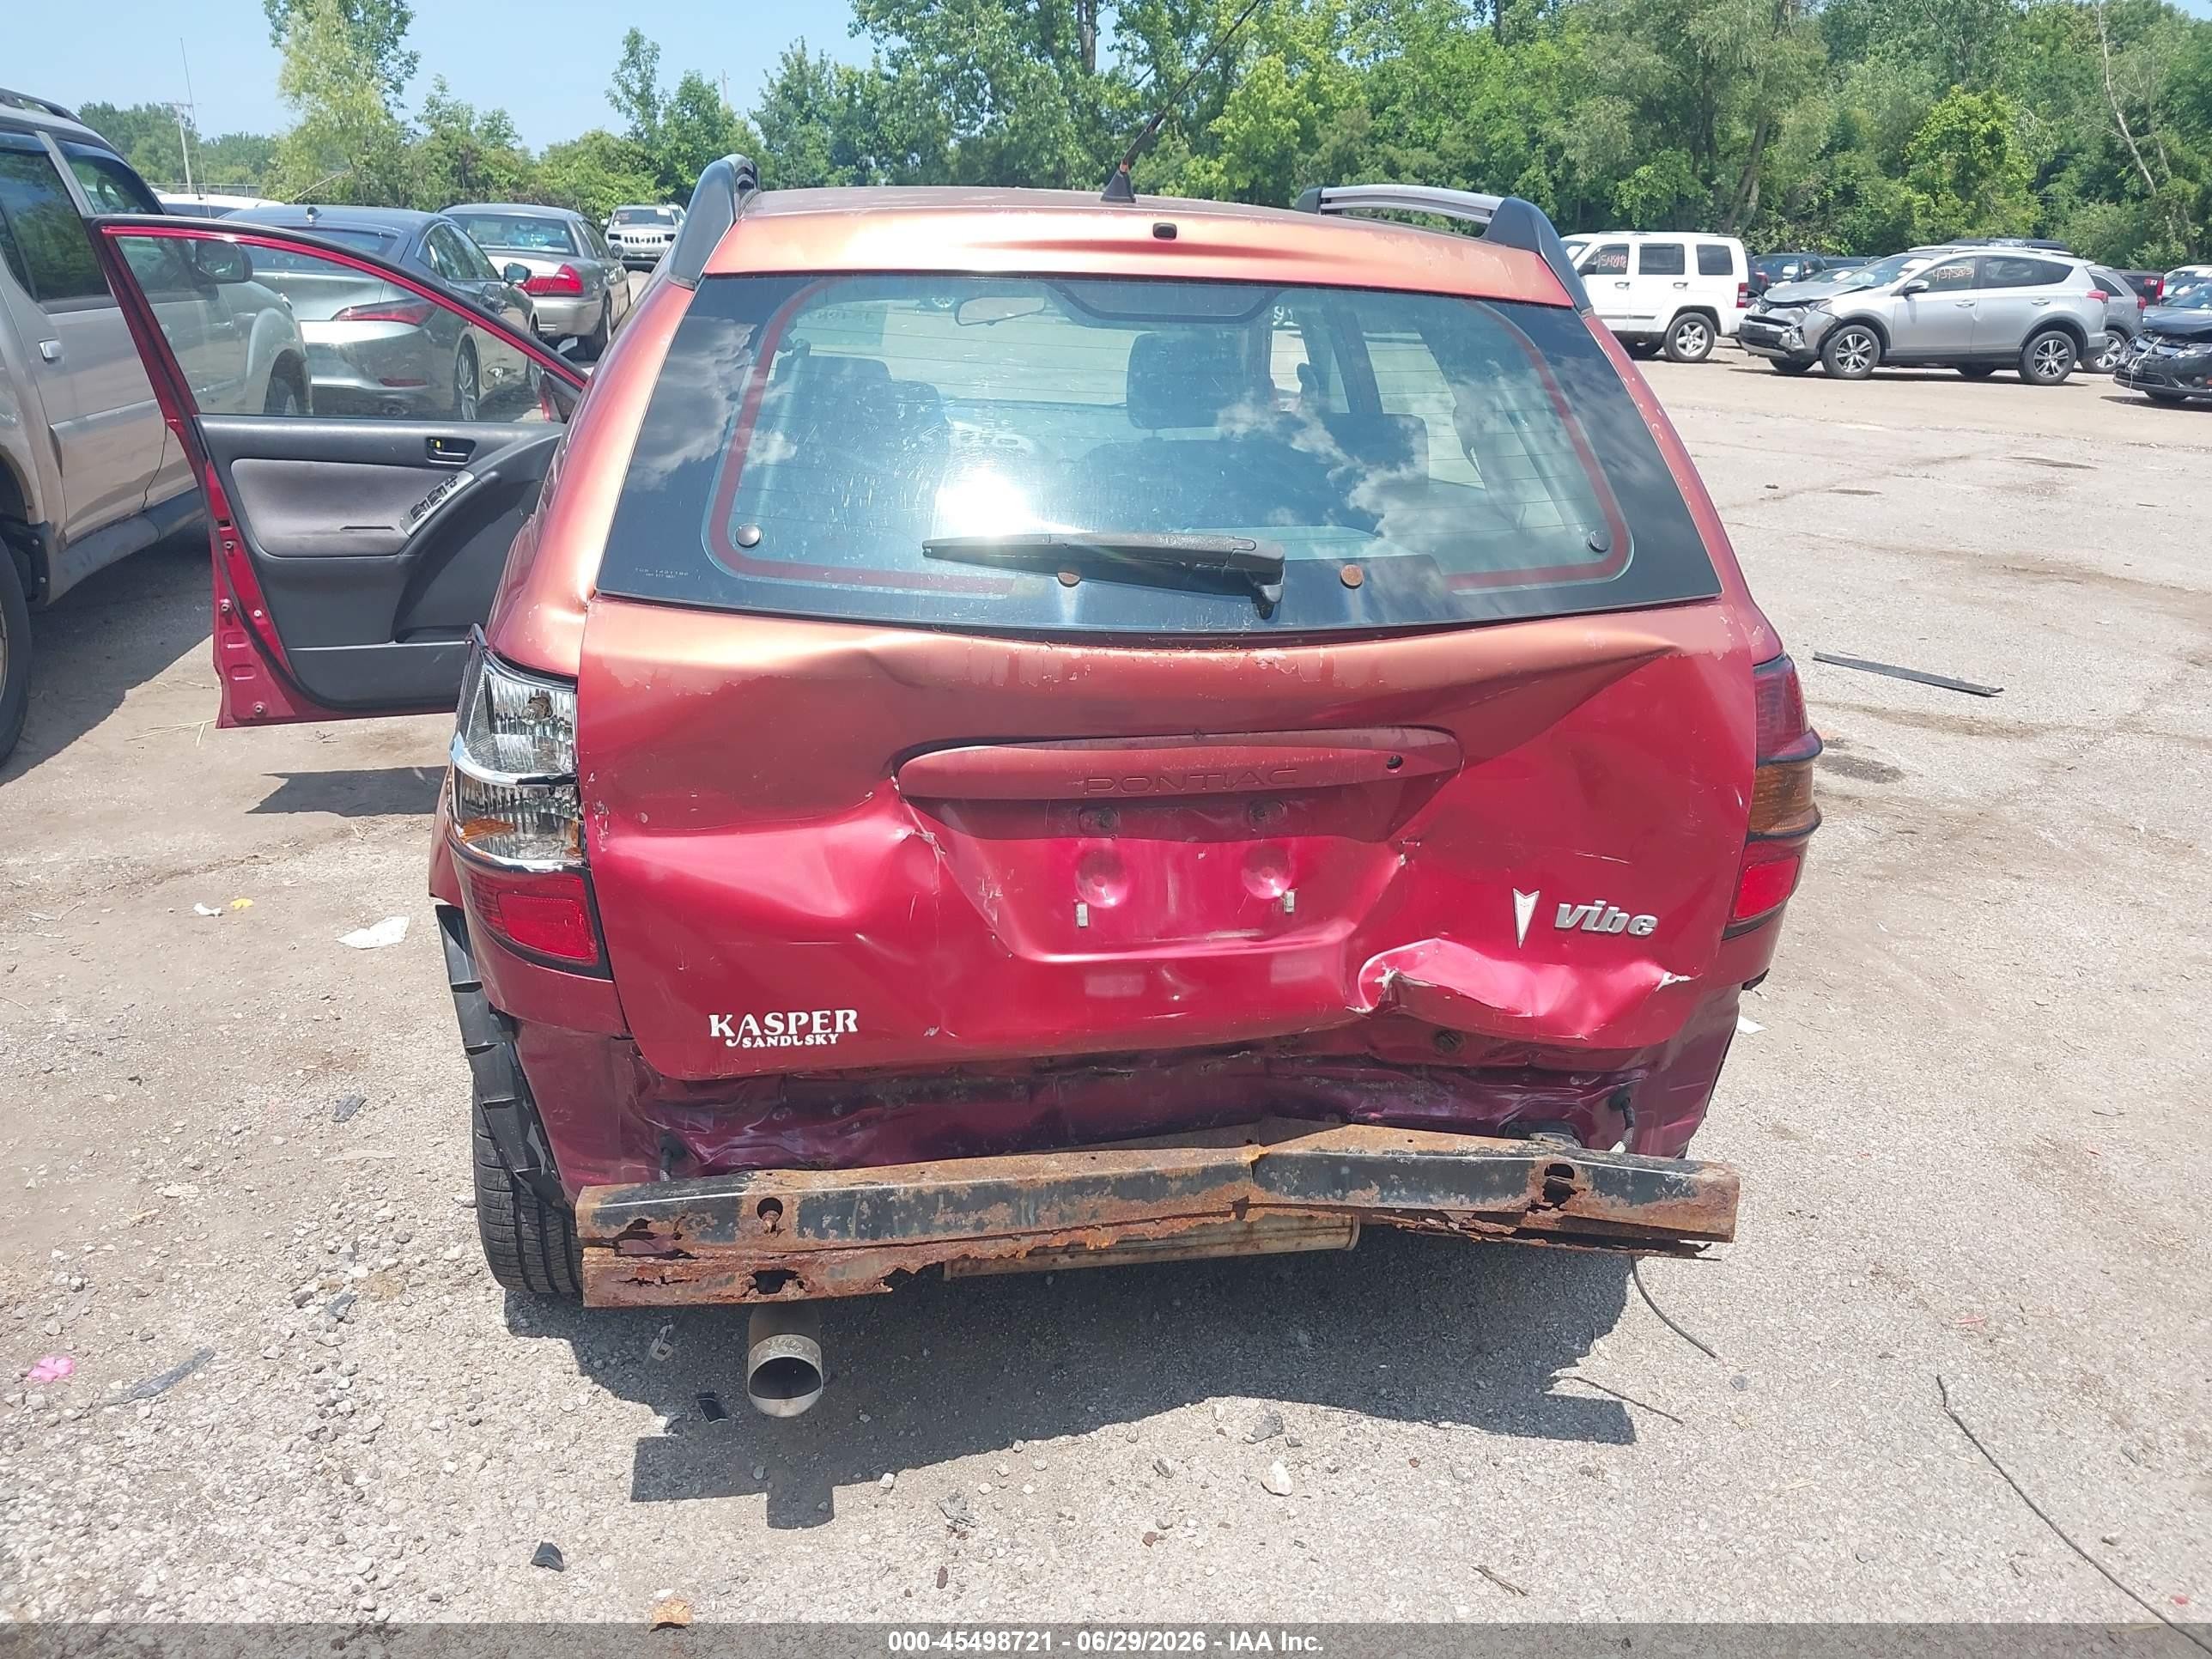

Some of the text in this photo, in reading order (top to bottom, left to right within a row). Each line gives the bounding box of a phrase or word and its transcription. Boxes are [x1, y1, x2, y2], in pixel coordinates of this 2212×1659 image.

[1084, 769, 1298, 794] PONTIAC
[1554, 900, 1659, 937] vibe
[708, 1008, 860, 1047] KASPER
[742, 1033, 839, 1048] SANDUSKY
